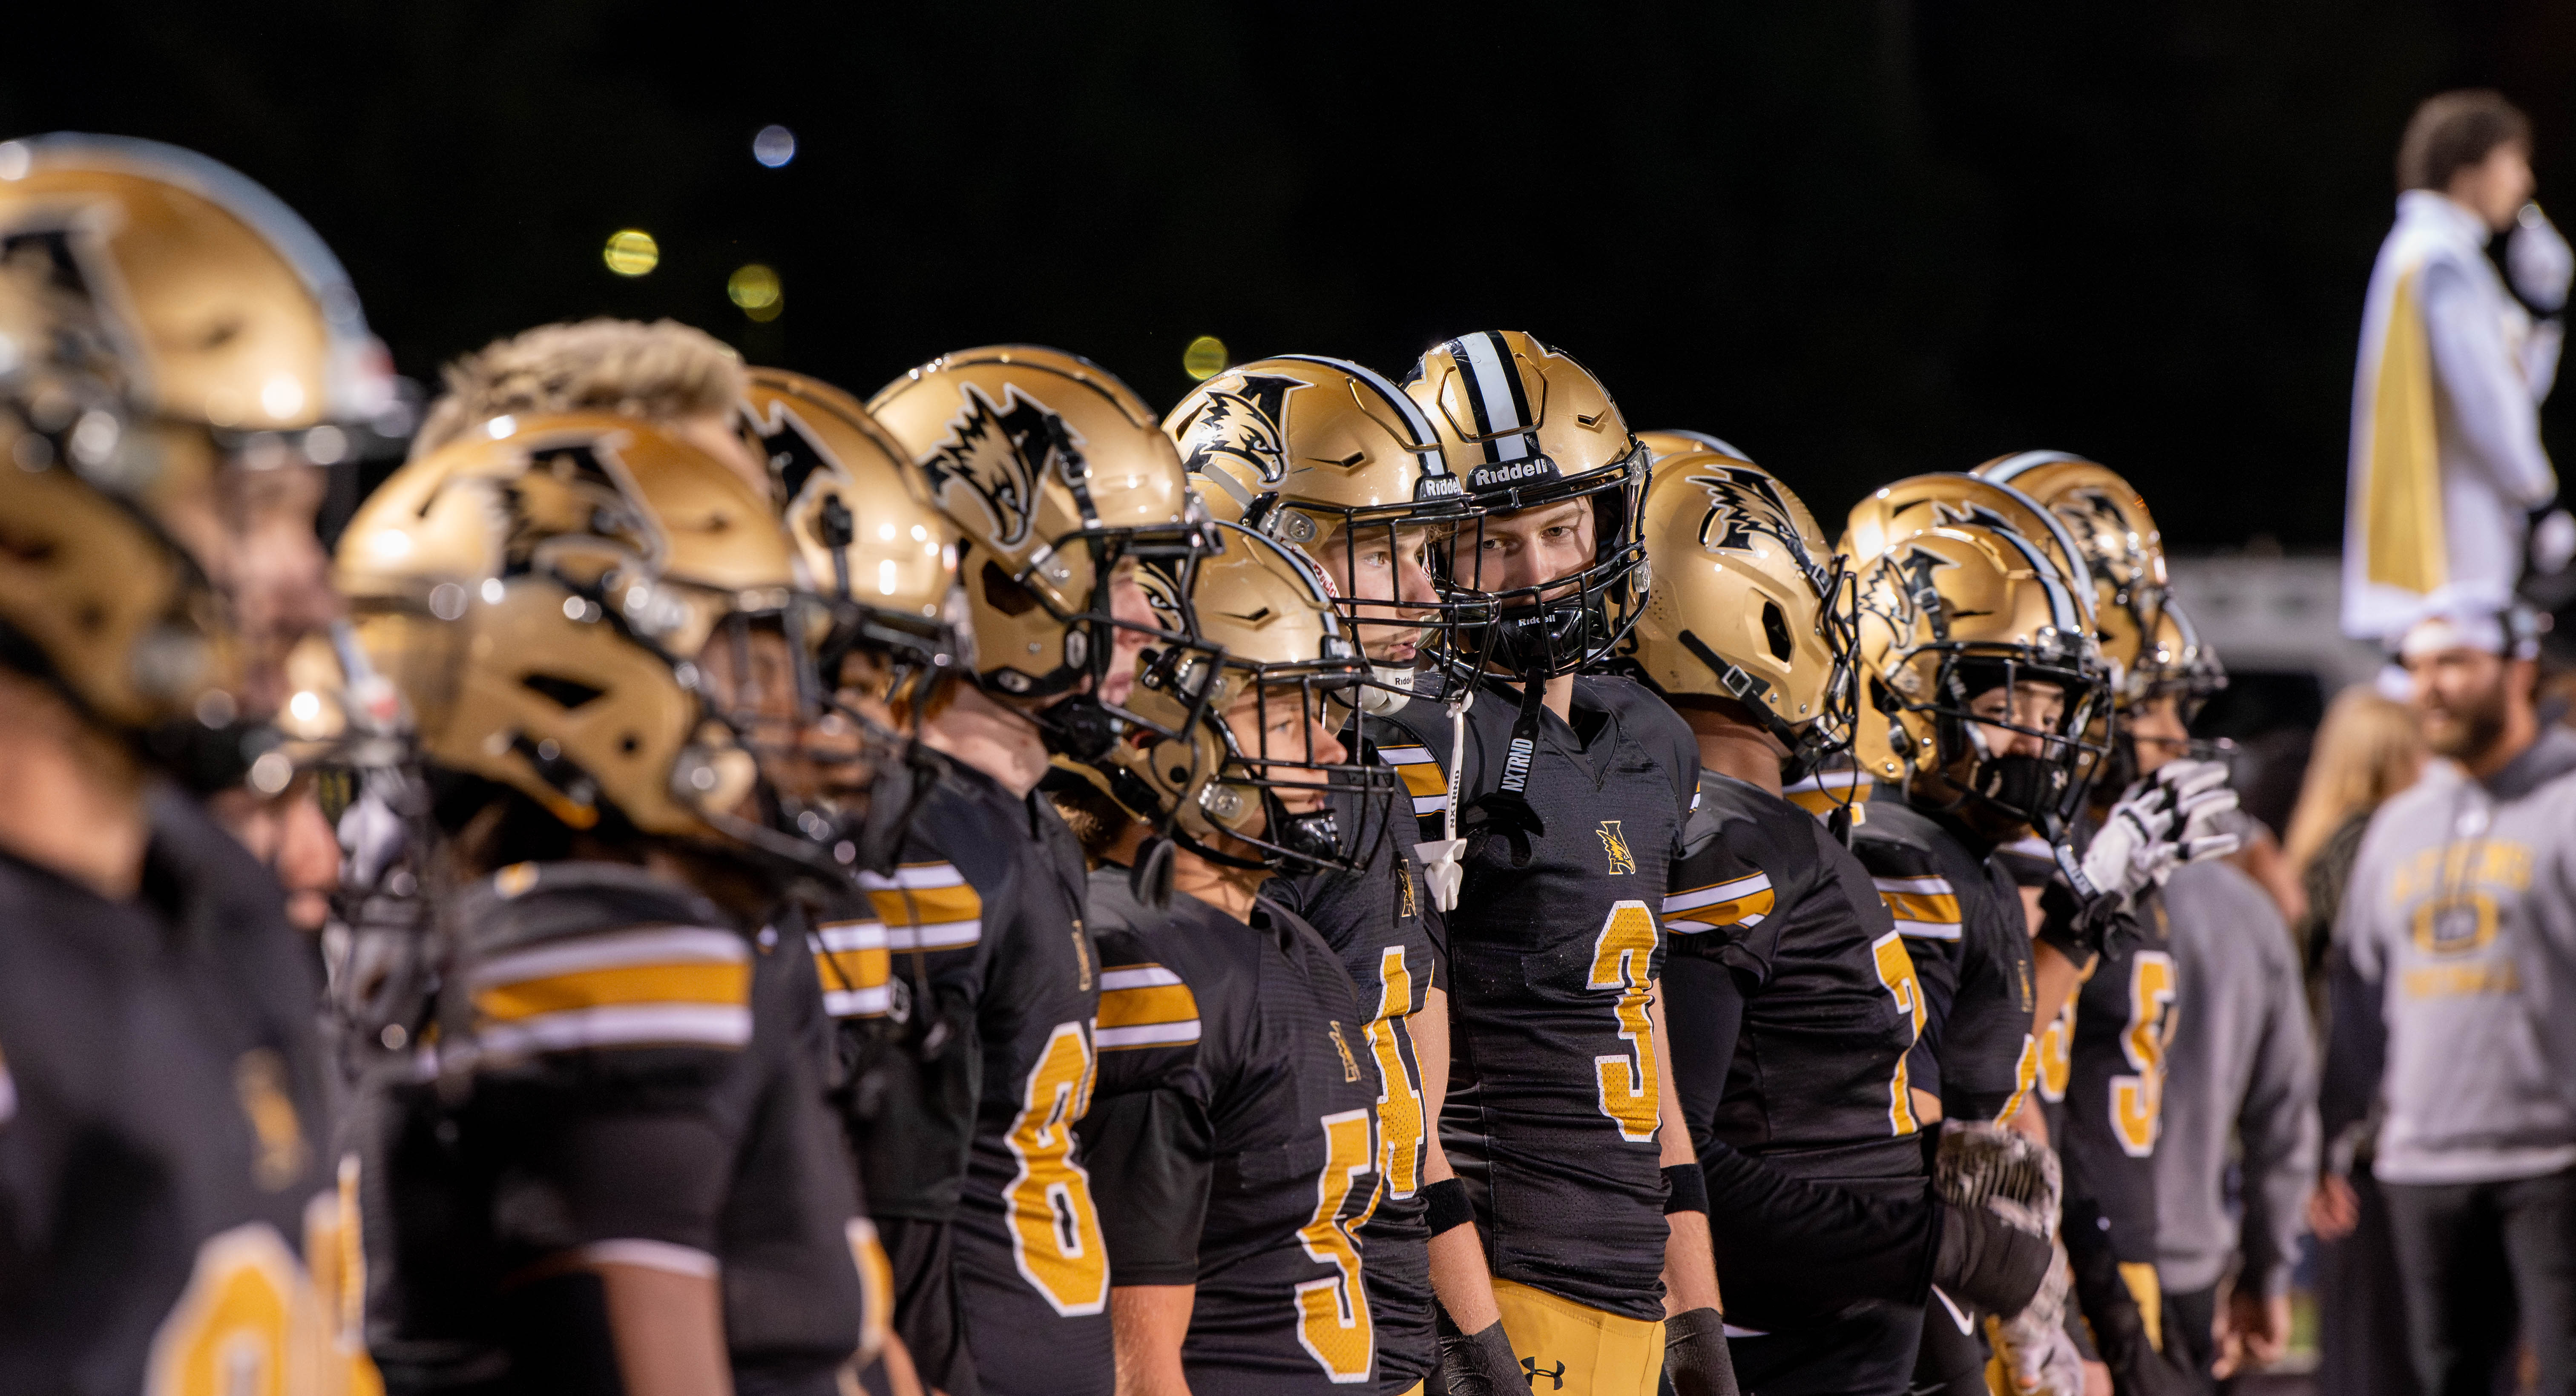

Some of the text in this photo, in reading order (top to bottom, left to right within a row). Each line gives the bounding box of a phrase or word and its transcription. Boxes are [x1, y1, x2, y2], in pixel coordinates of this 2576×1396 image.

[1475, 458, 1548, 486] Riddell
[1450, 770, 1460, 828] NXTRND
[1501, 738, 1533, 792] NXTRND
[1586, 900, 1661, 1142] 3
[2108, 950, 2177, 1157] 5
[1002, 1018, 1110, 1317] 8
[1294, 1108, 1384, 1384] 5
